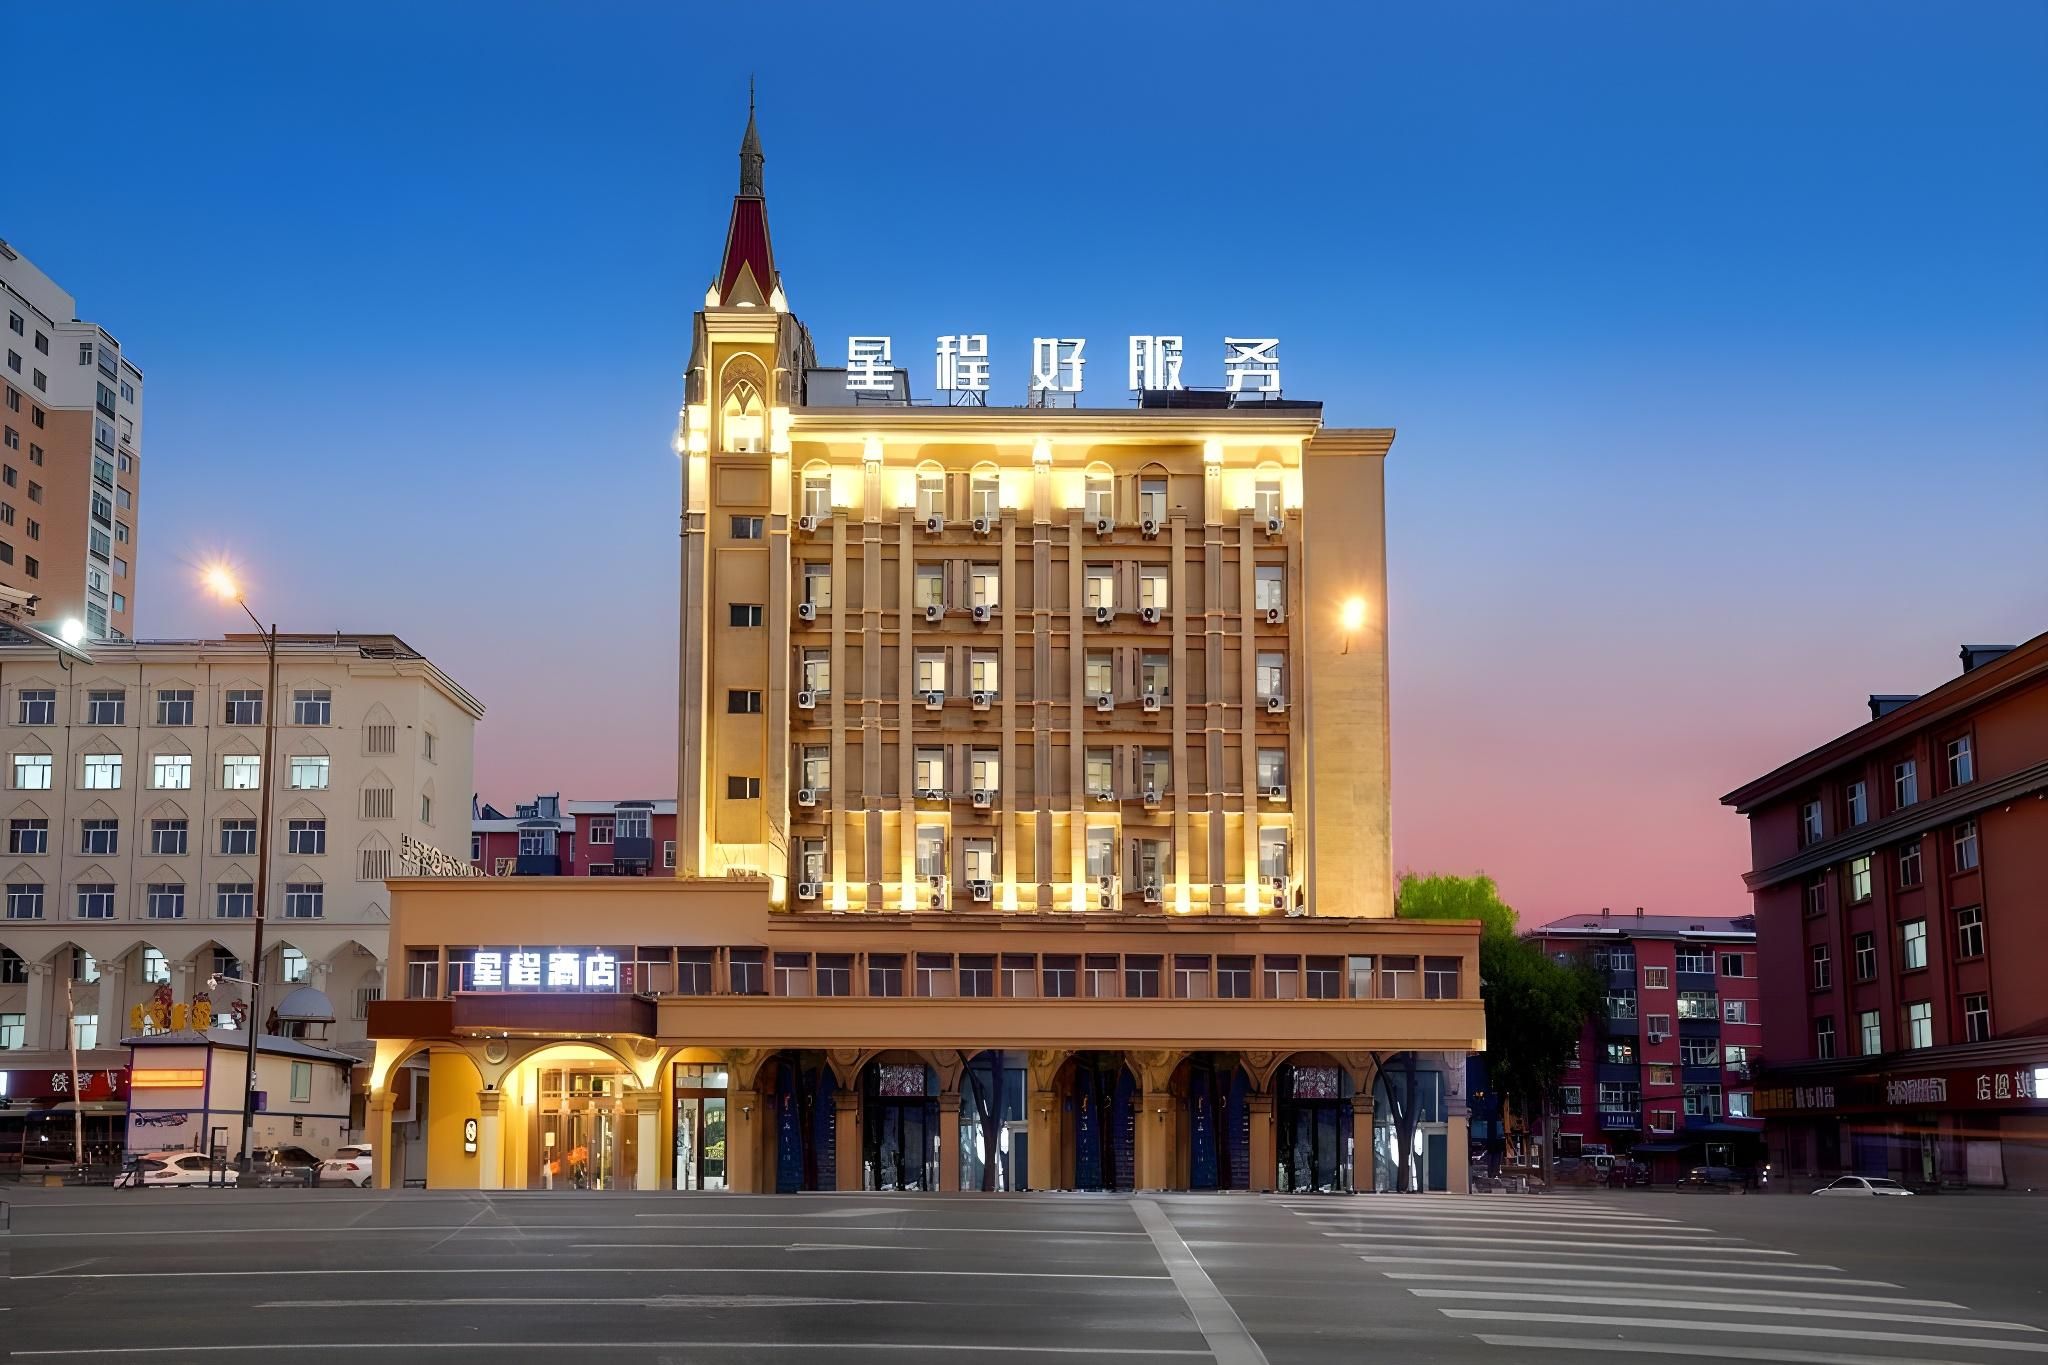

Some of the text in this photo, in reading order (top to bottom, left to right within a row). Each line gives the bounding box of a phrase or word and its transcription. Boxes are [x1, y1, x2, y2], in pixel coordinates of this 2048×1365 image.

[846, 334, 1280, 393] 星程好服务
